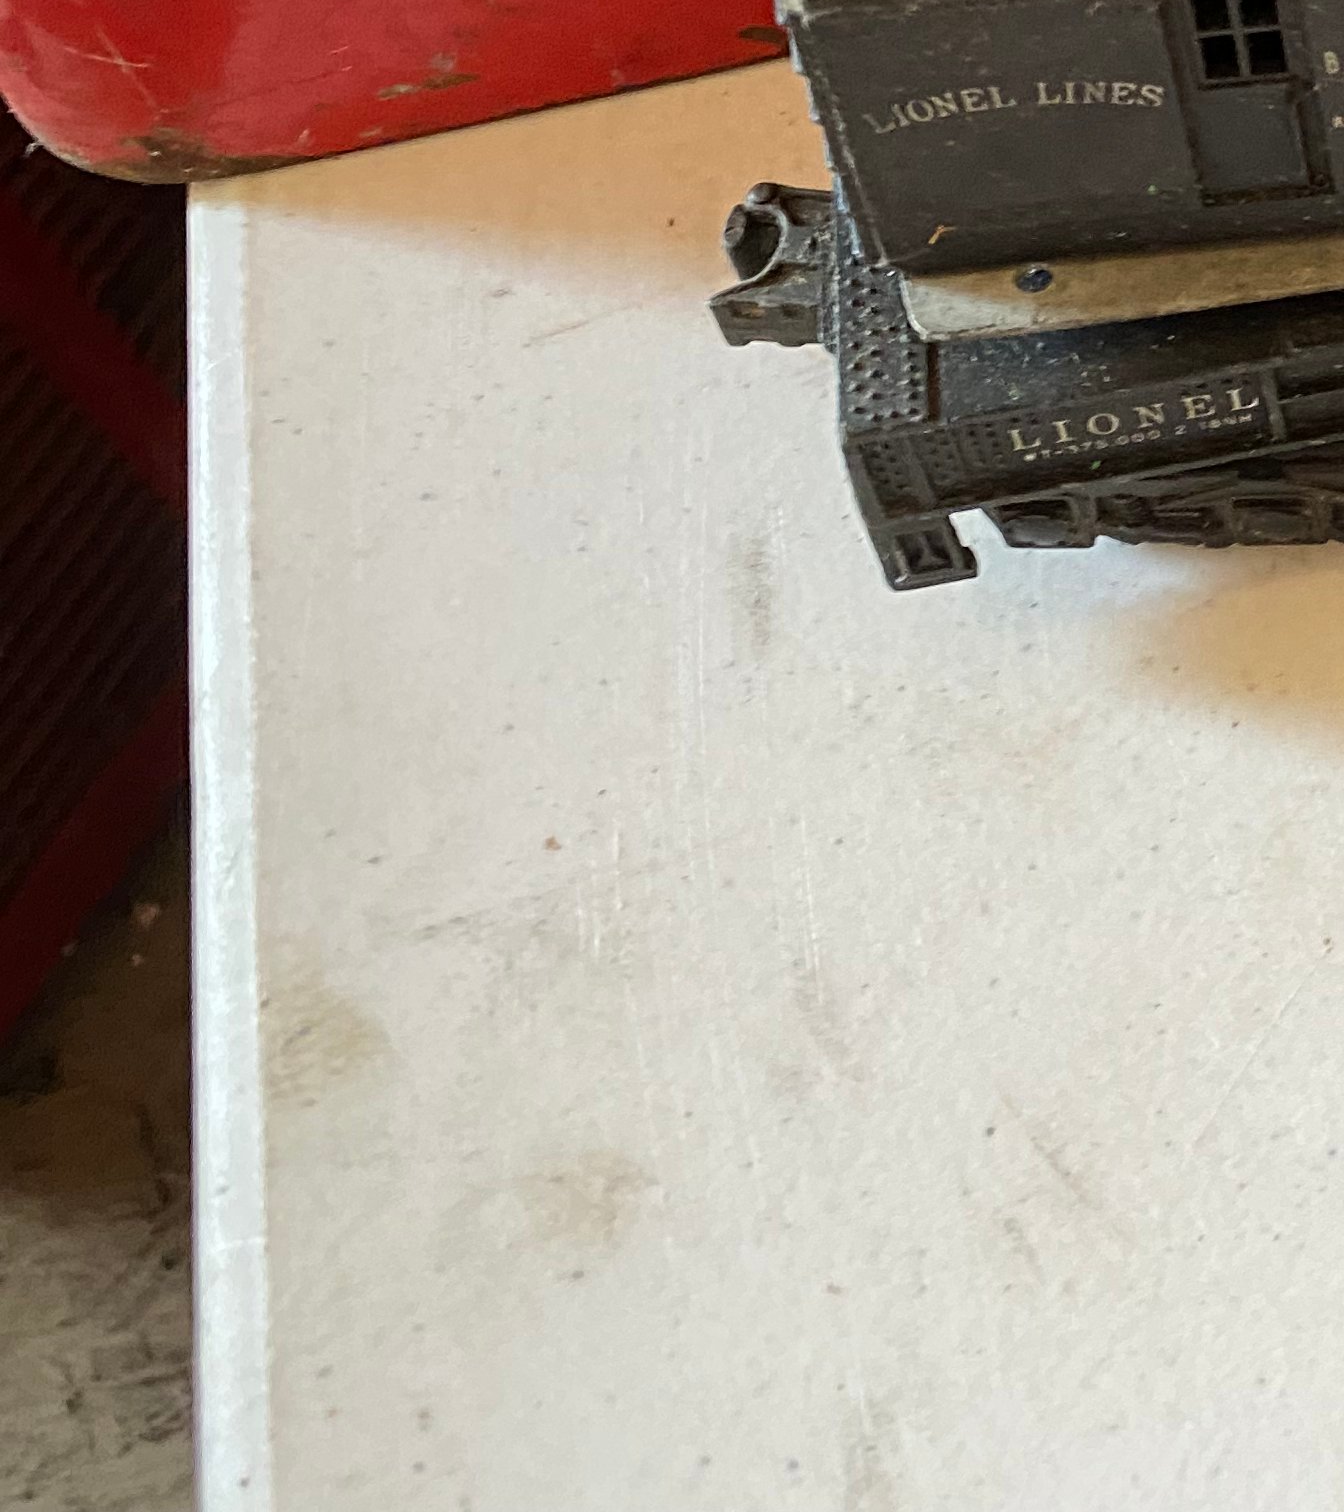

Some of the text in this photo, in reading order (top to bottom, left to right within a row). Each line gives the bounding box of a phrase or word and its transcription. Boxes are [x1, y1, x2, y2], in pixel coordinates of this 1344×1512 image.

[861, 81, 1165, 135] LIONEL LINES
[1006, 388, 1260, 452] LIONEL
